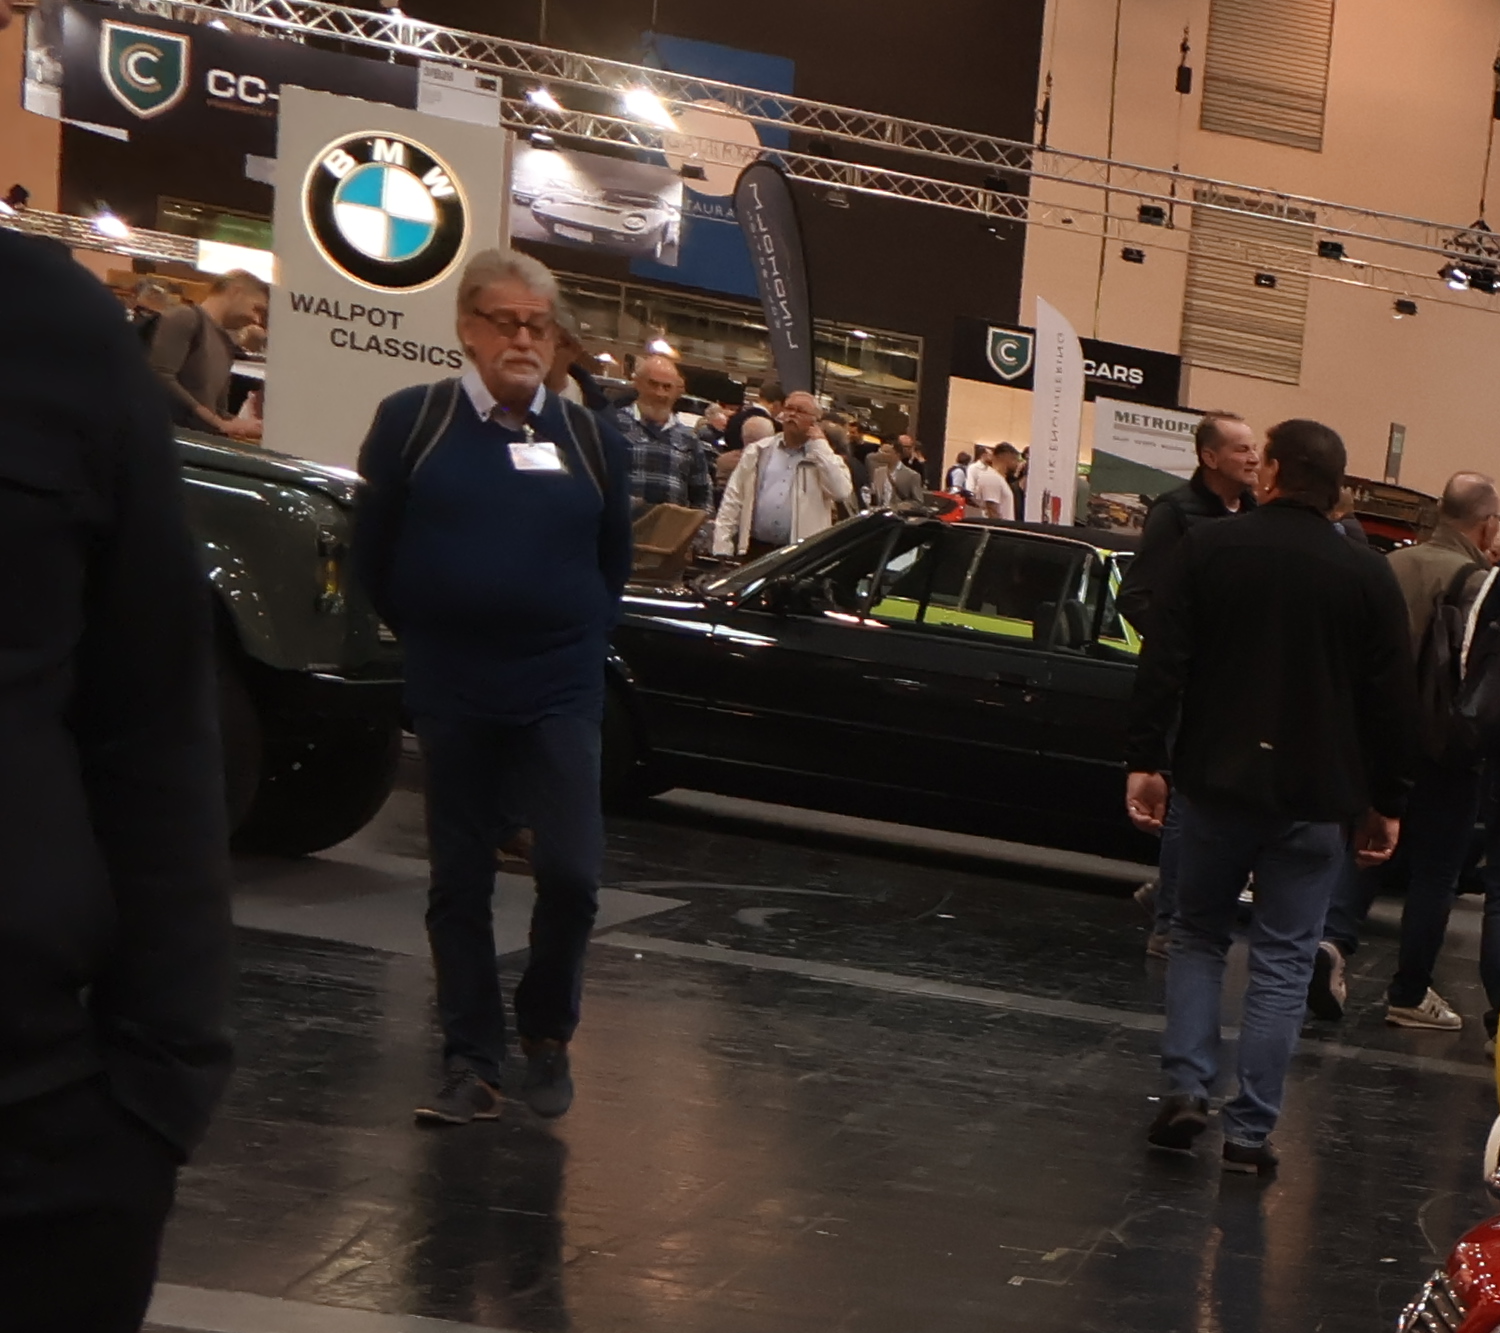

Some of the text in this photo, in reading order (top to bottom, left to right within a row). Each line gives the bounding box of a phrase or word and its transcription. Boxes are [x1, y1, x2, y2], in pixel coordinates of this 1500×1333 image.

[206, 69, 279, 105] CC-
[323, 138, 455, 199] BMW
[289, 293, 404, 331] WALPOT
[330, 328, 463, 370] CLASSICS
[1083, 359, 1144, 385] CARS
[1114, 410, 1198, 435] METROPO
